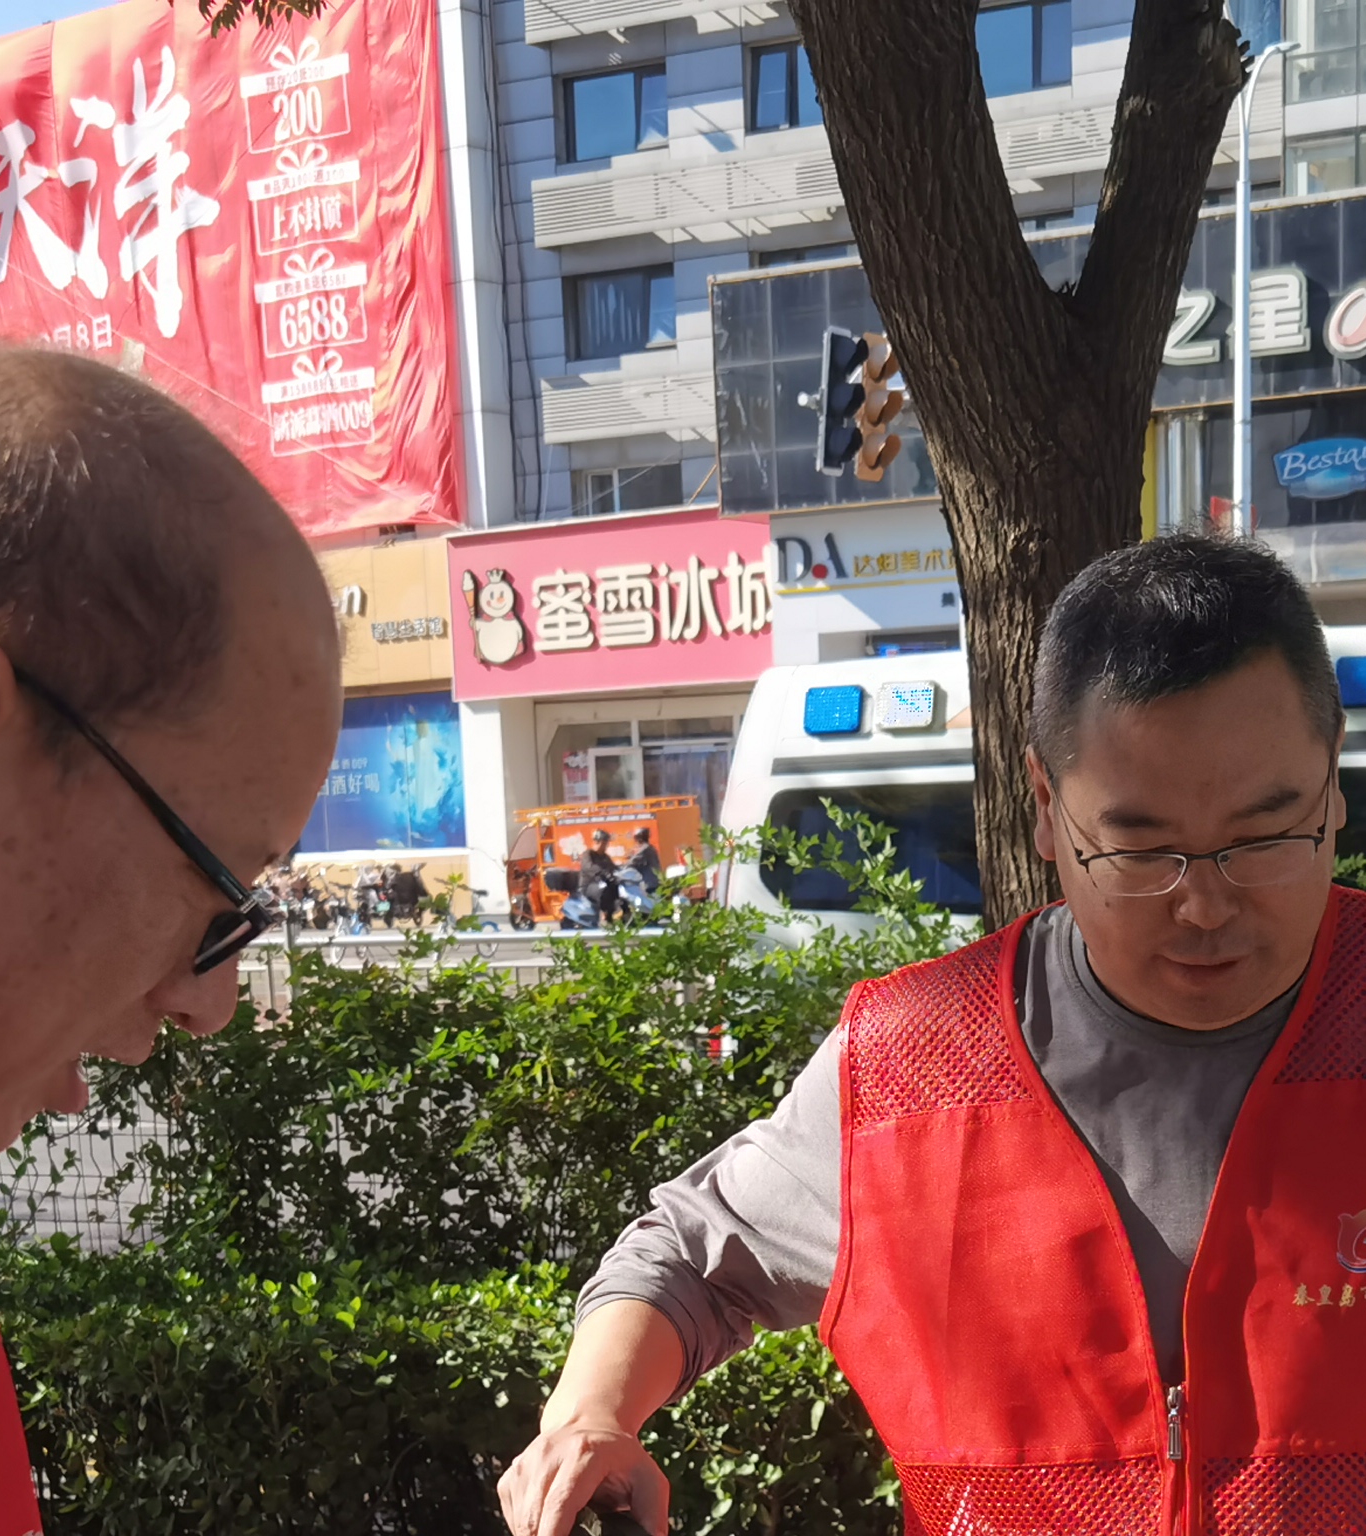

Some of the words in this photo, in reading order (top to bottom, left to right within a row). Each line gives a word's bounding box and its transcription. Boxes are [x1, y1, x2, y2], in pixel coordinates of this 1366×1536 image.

[273, 86, 323, 142] 200
[270, 193, 343, 241] 上不封顶
[280, 294, 349, 348] 6588
[531, 542, 779, 652] 蜜雪冰城
